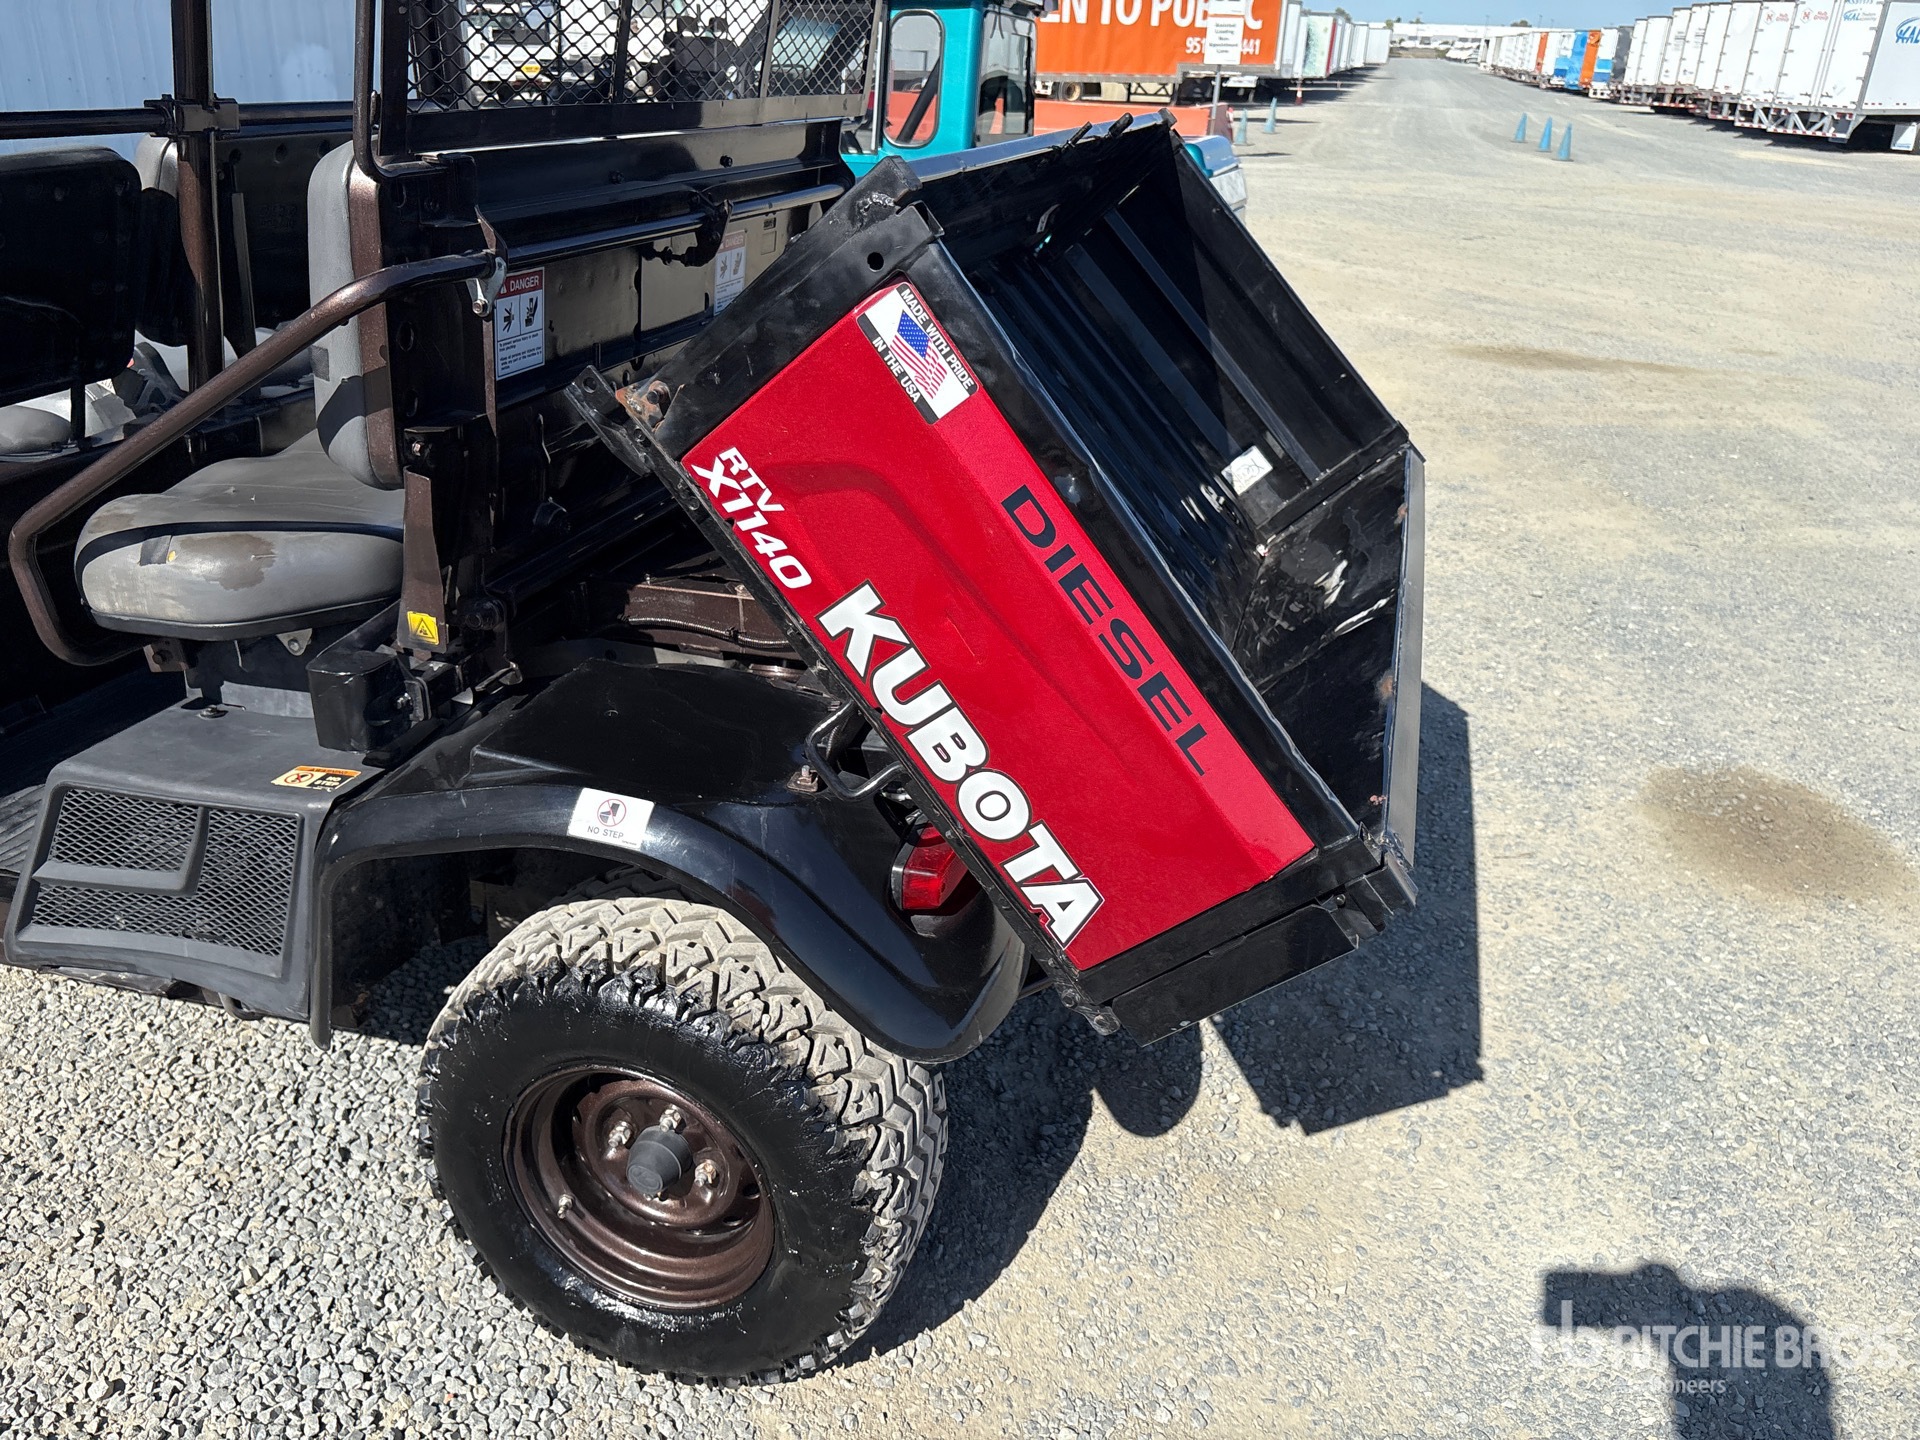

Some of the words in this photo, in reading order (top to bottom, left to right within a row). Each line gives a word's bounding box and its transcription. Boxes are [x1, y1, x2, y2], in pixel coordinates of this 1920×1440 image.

[510, 276, 539, 291] DANGER
[871, 336, 888, 353] IN
[883, 351, 903, 376] THE
[900, 375, 921, 403] USA
[901, 289, 929, 324] MADE
[925, 322, 951, 355] WITH
[946, 354, 975, 390] PRIDE
[718, 446, 785, 512] RTV
[691, 456, 812, 589] X1140
[1000, 484, 1208, 776] DIESEL
[815, 579, 1105, 951] KUBOTA
[587, 825, 600, 834] NO
[603, 828, 624, 839] STEP
